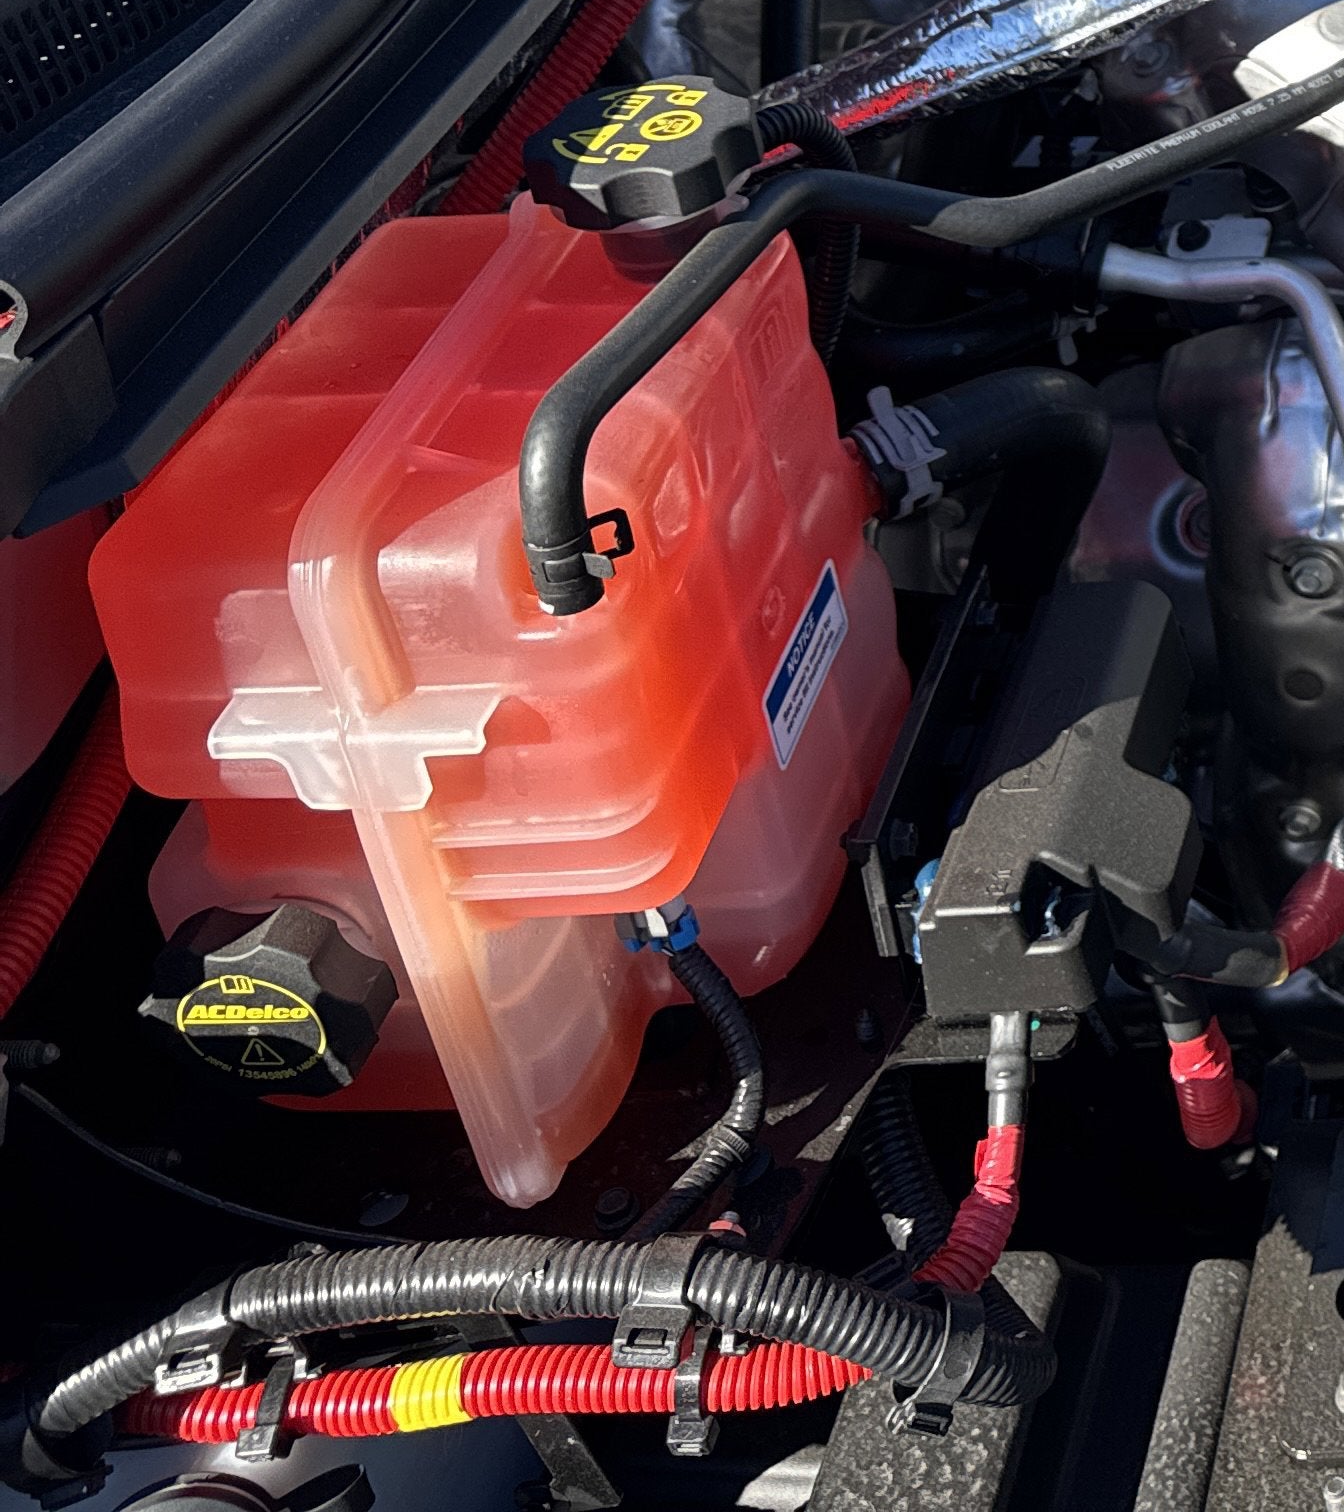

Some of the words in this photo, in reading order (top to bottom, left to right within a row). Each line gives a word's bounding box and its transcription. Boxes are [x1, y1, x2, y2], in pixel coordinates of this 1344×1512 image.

[1106, 146, 1161, 171] FLEETRITE
[1159, 128, 1202, 151] PREMIUM
[1201, 112, 1241, 133] COOLANT
[786, 611, 816, 677] NOTICE
[186, 1004, 309, 1020] ACDelco
